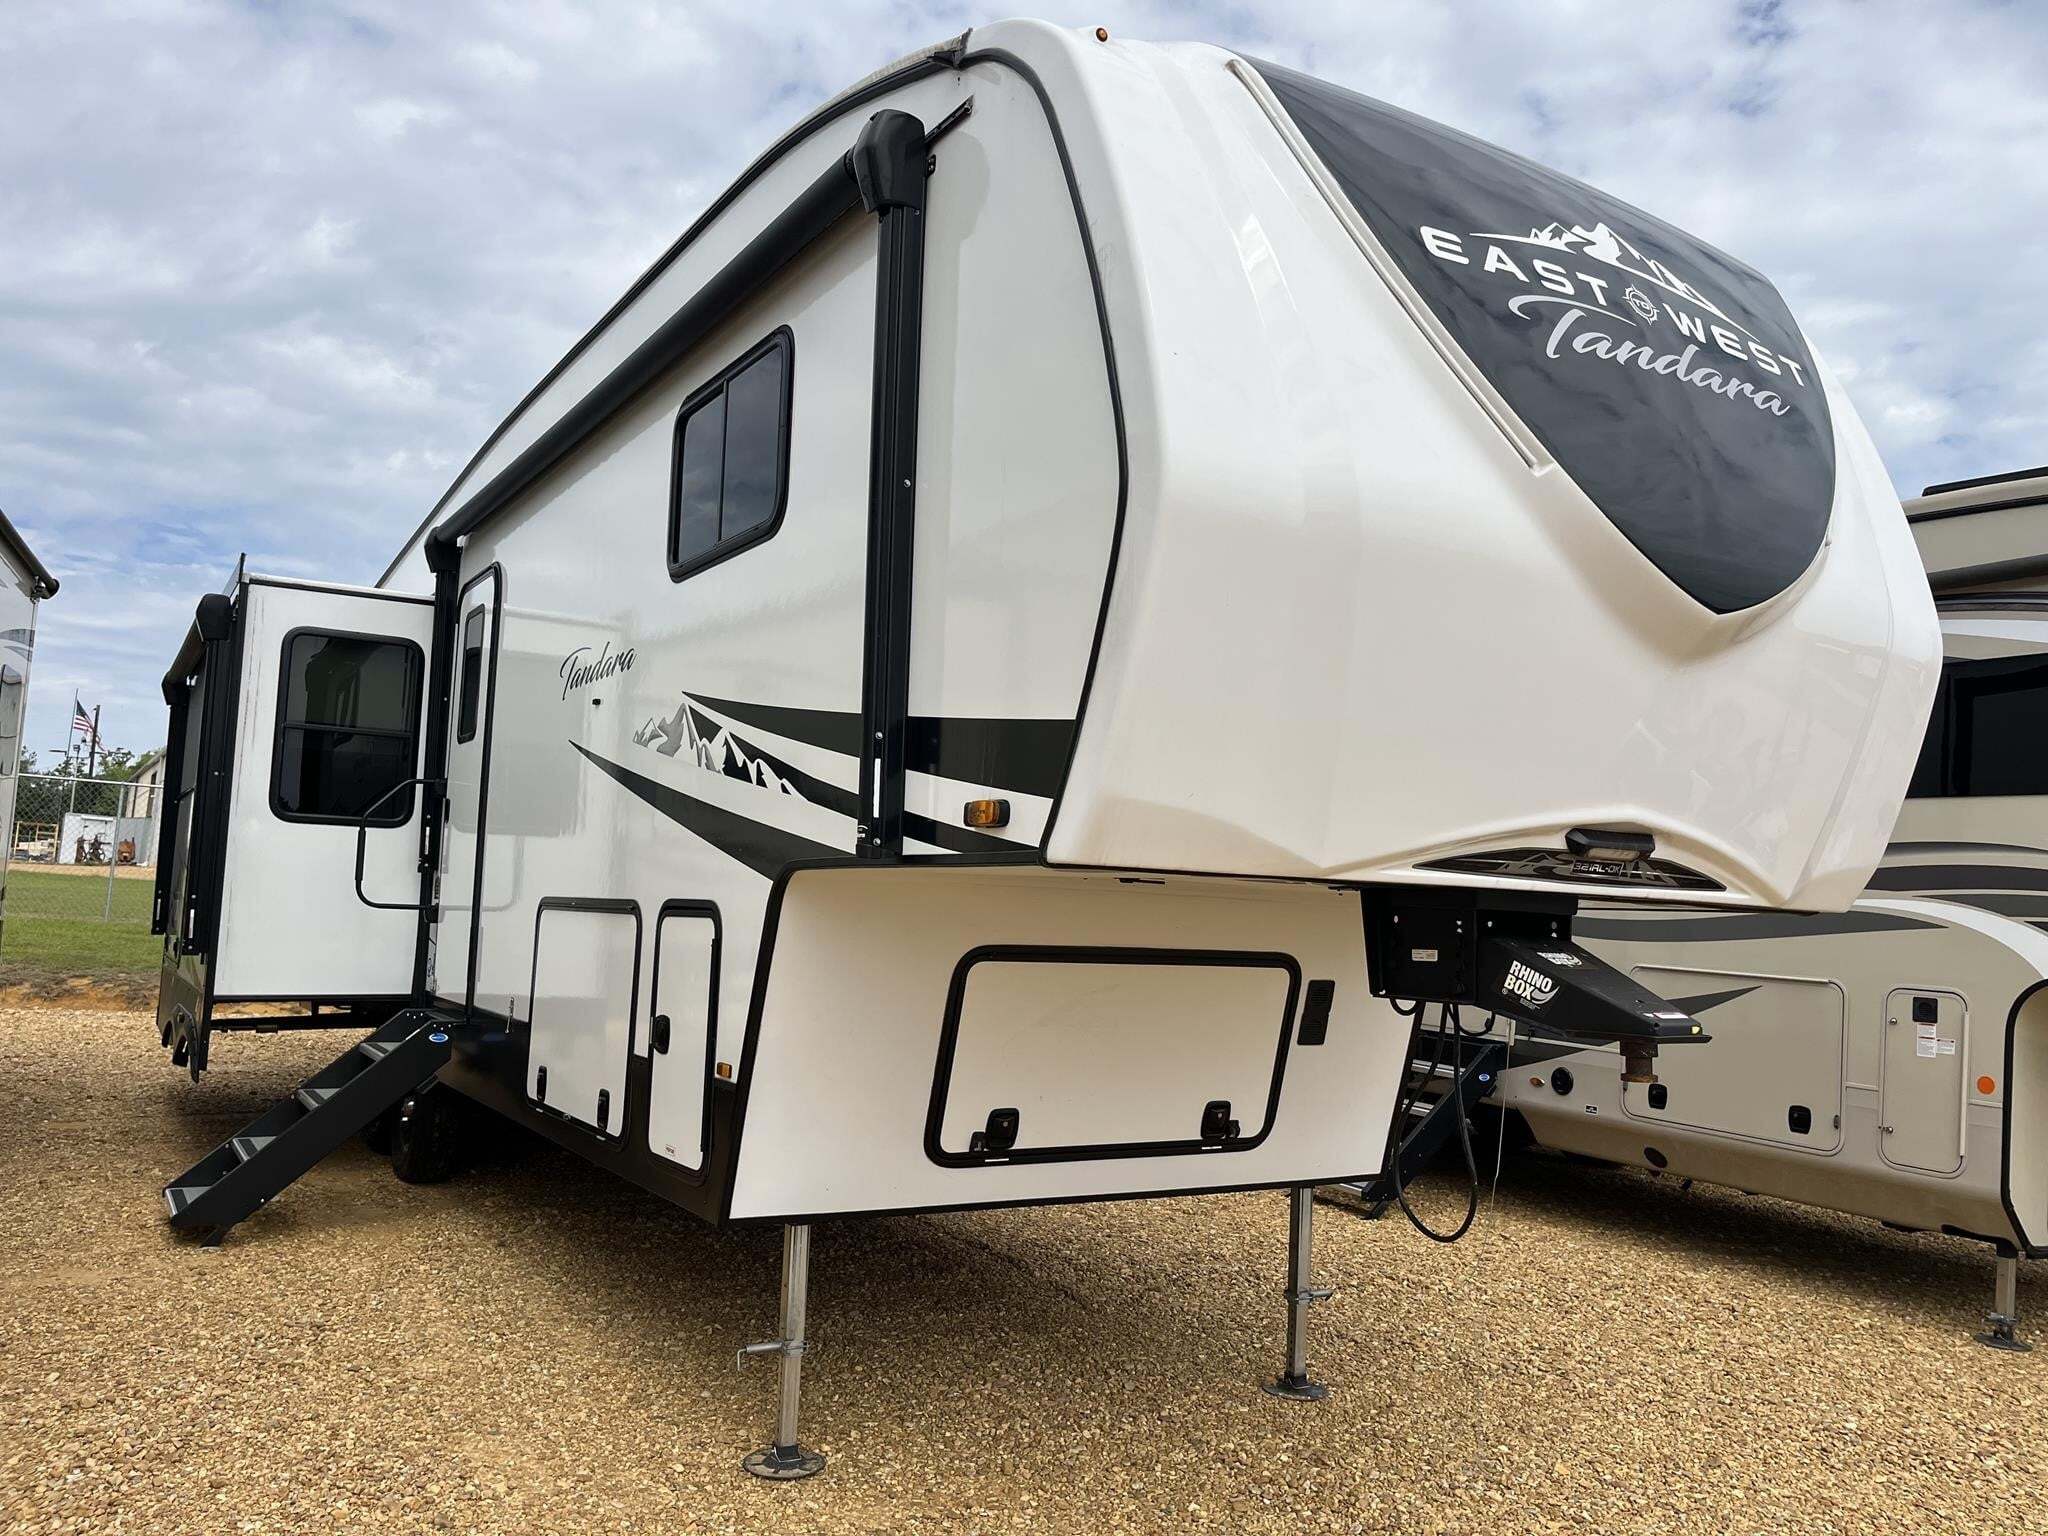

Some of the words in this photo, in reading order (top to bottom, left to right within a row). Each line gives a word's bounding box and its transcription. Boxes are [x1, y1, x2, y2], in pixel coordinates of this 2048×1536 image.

[1420, 225, 1608, 307] EAST
[1663, 303, 1805, 387] WEST
[1508, 294, 1791, 416] Tandara
[559, 640, 637, 701] Tandara
[1503, 973, 1535, 1001] BOX
[1509, 960, 1553, 992] RHINO
